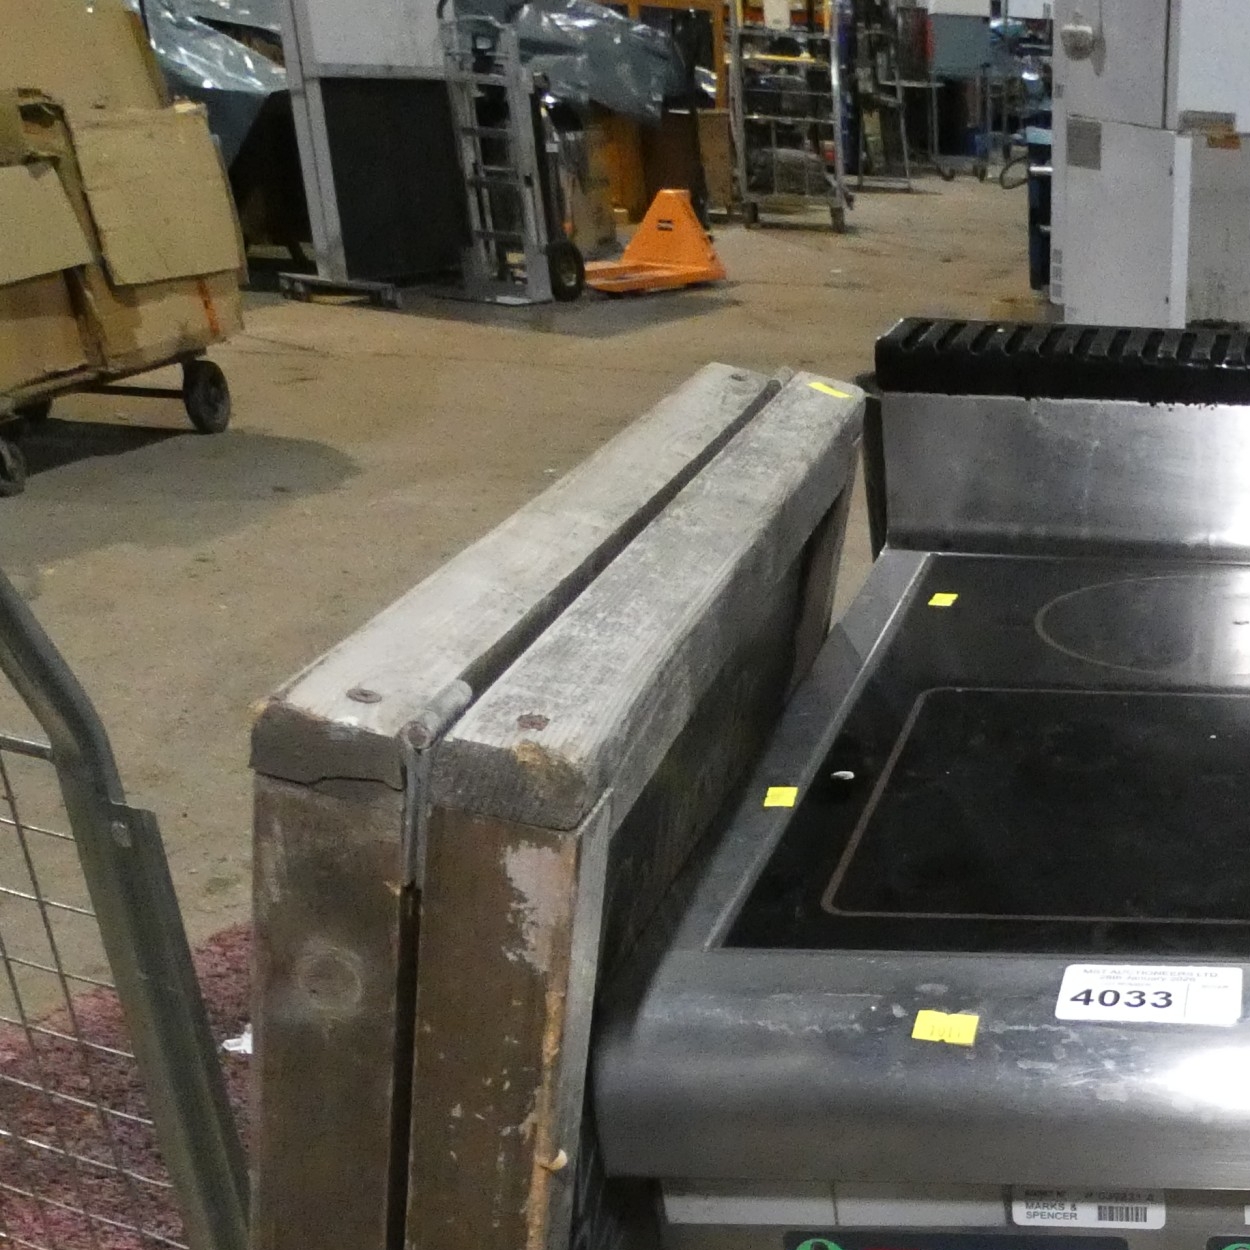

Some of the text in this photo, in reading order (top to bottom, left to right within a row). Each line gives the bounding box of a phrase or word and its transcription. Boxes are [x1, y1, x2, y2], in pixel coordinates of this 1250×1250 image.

[1070, 988, 1173, 1009] 4033
[1025, 1201, 1078, 1212] MARKS &
[1025, 1211, 1078, 1221] SPENCER
